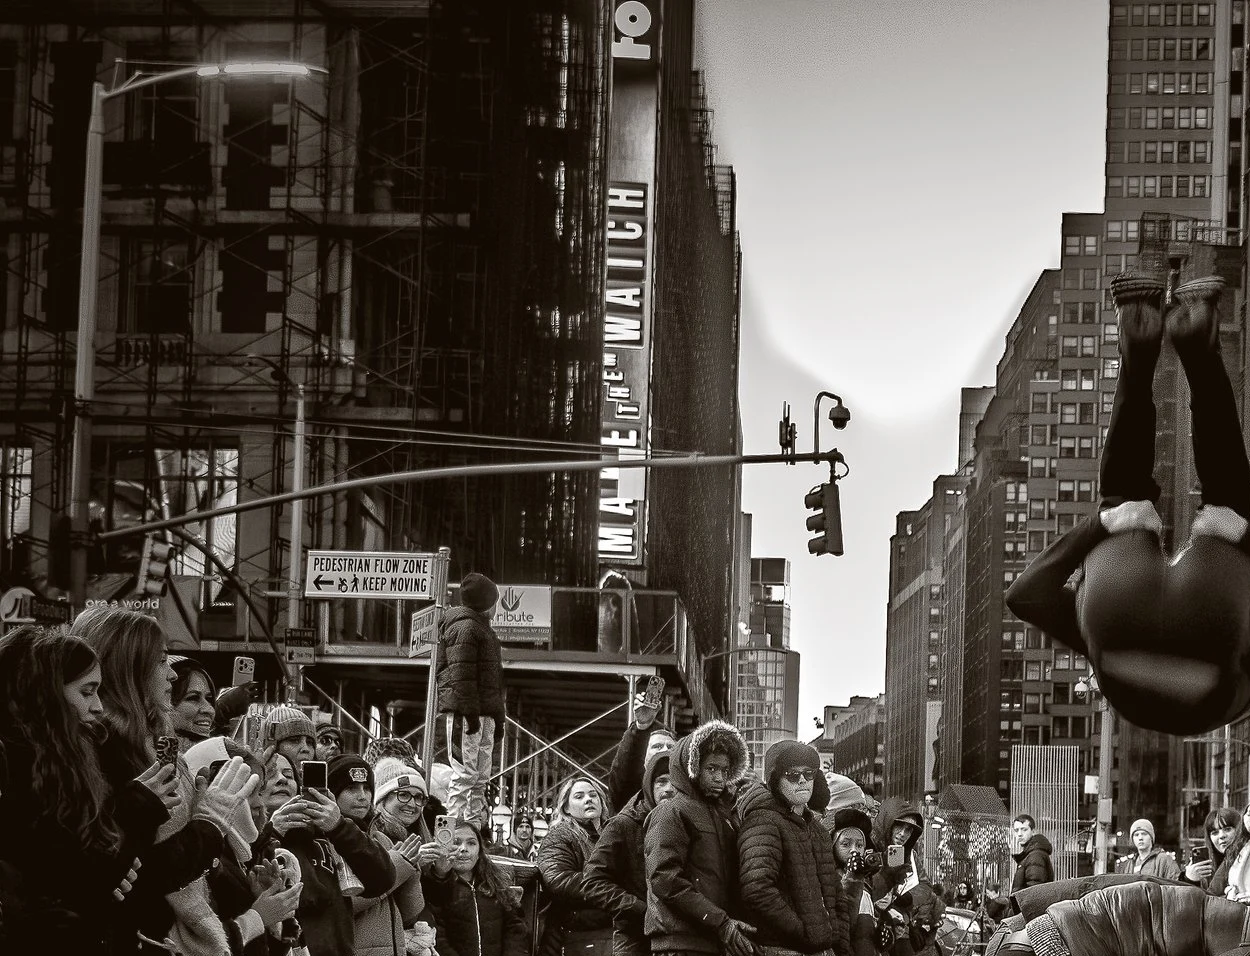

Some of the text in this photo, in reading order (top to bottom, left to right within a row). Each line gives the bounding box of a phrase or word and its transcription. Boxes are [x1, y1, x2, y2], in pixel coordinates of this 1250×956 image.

[603, 353, 639, 414] THEM
[313, 557, 428, 574] PEDESTRIAN FLOW ZONE
[362, 576, 427, 592] KEEP MOVING
[121, 598, 160, 610] world
[495, 611, 534, 623] ribute
